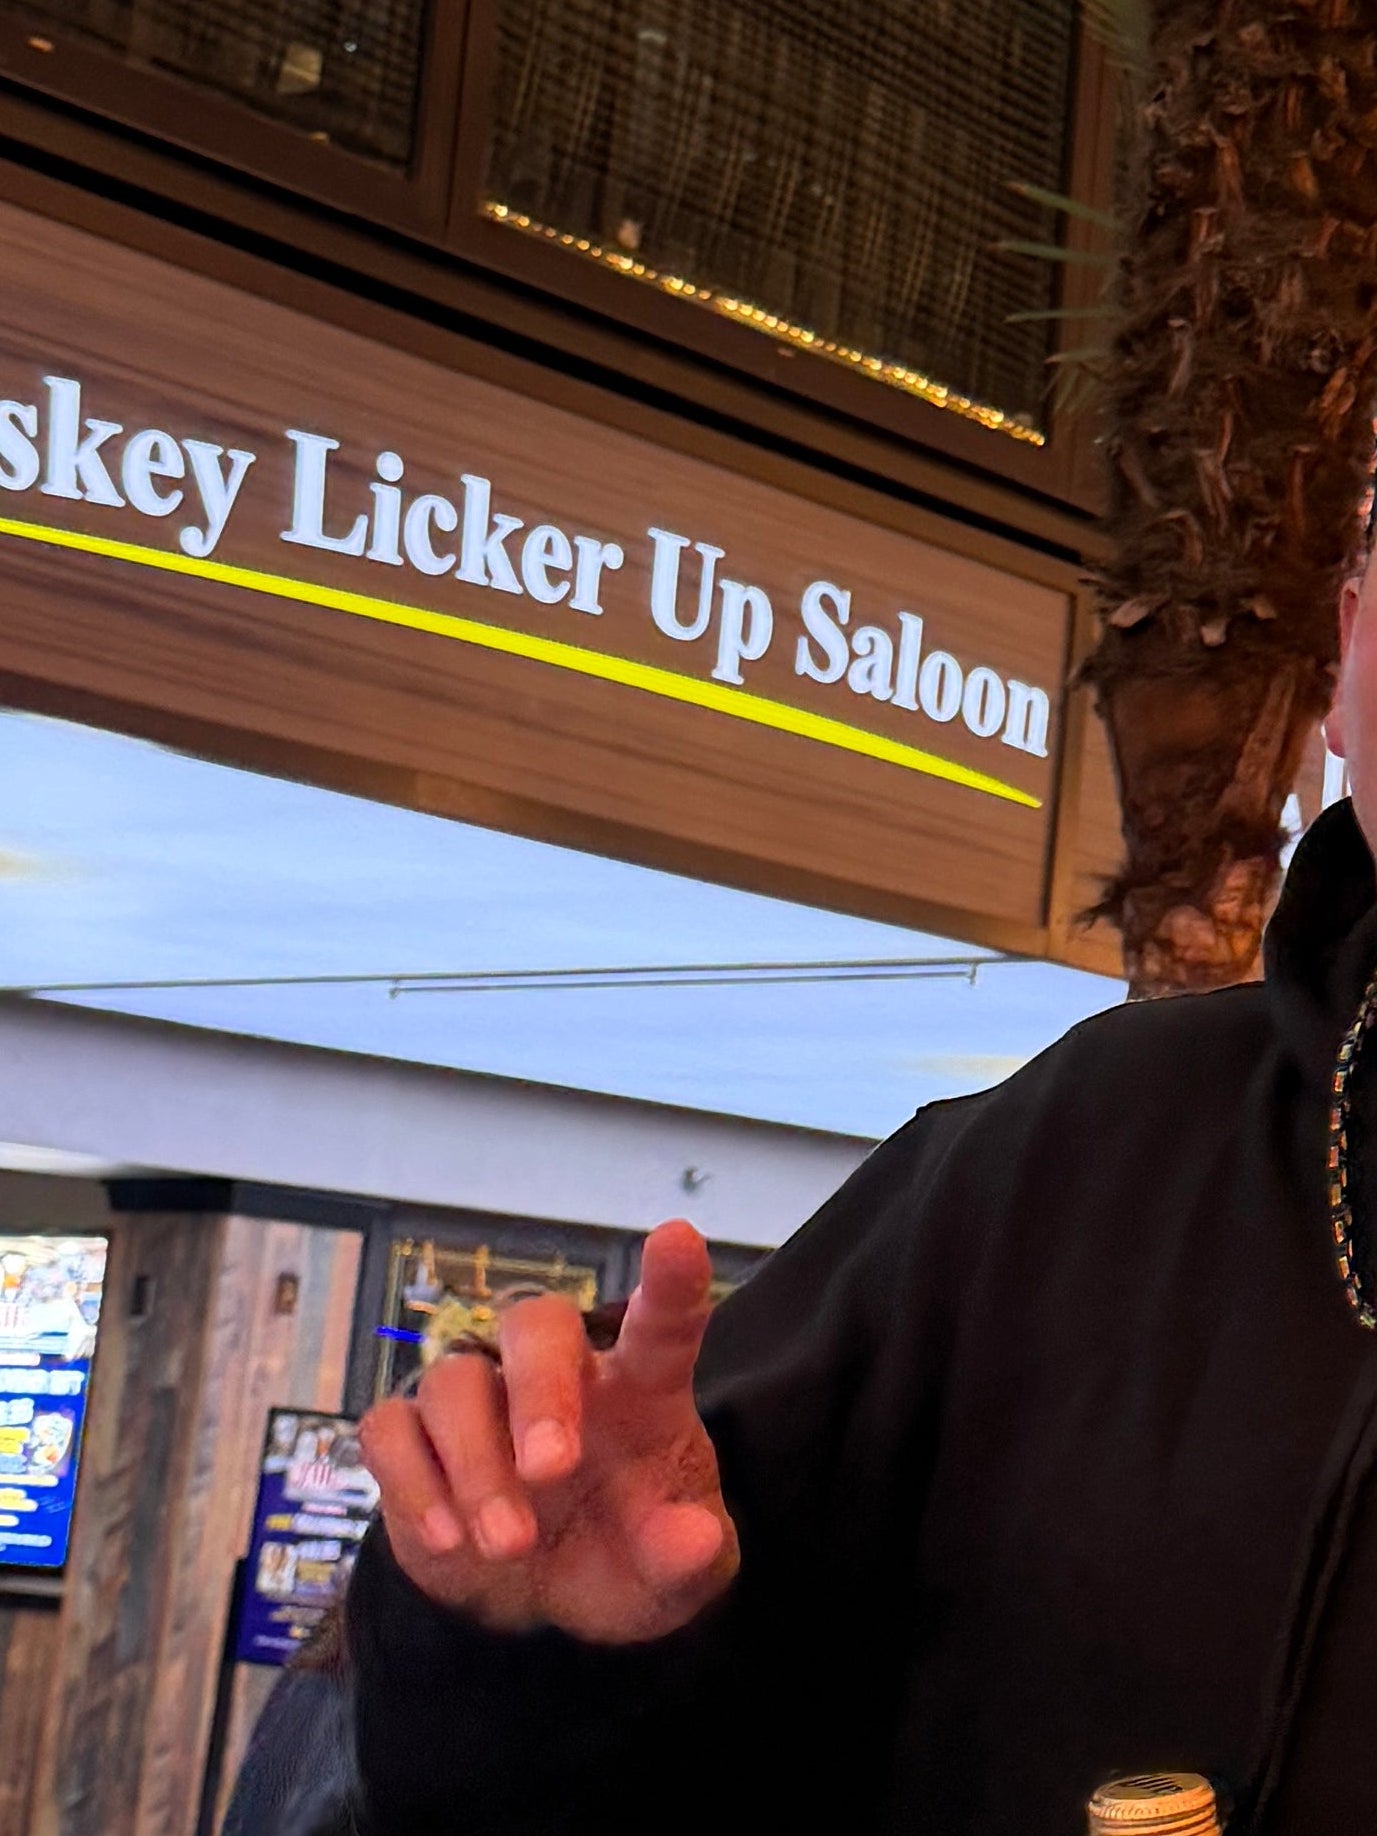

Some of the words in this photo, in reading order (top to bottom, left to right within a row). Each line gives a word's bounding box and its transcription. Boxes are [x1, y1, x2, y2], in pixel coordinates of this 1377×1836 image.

[0, 376, 256, 557] skey
[280, 429, 624, 617] Licker
[648, 527, 774, 686] Up
[796, 581, 1051, 758] Saloon
